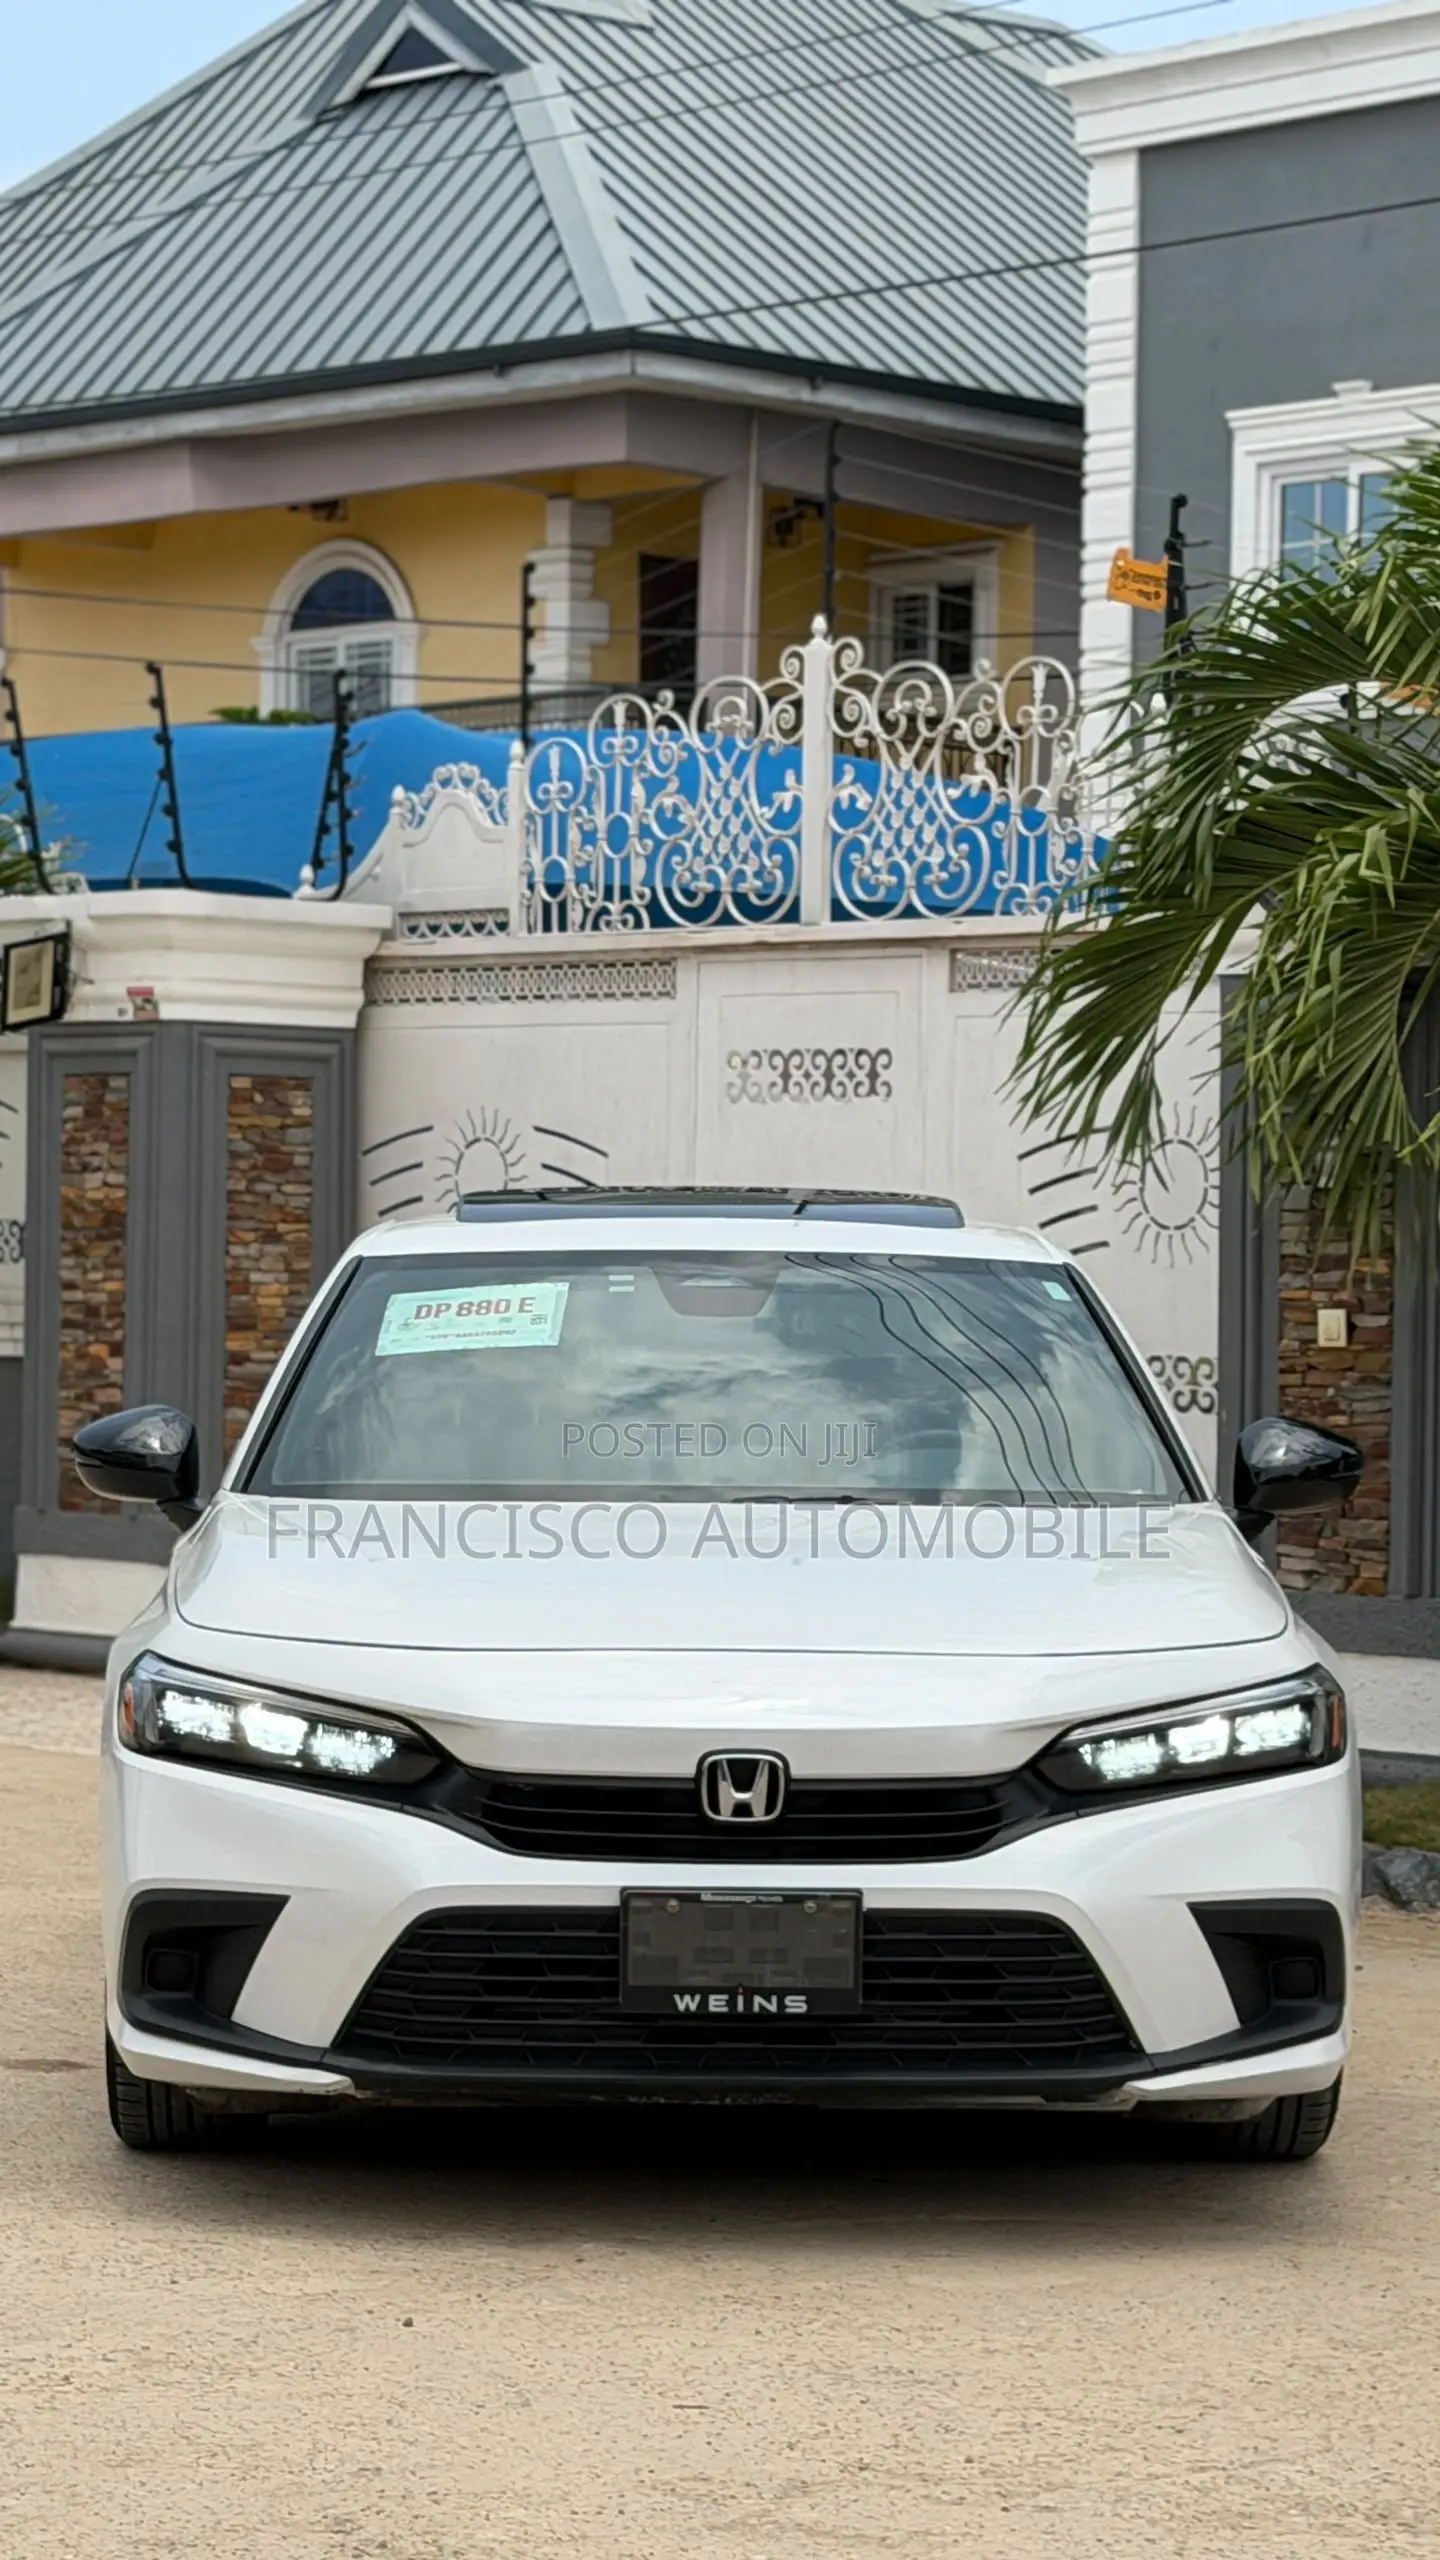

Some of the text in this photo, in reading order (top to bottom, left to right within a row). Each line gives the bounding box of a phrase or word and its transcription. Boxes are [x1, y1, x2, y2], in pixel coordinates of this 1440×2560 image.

[414, 1297, 536, 1320] DP 880 E
